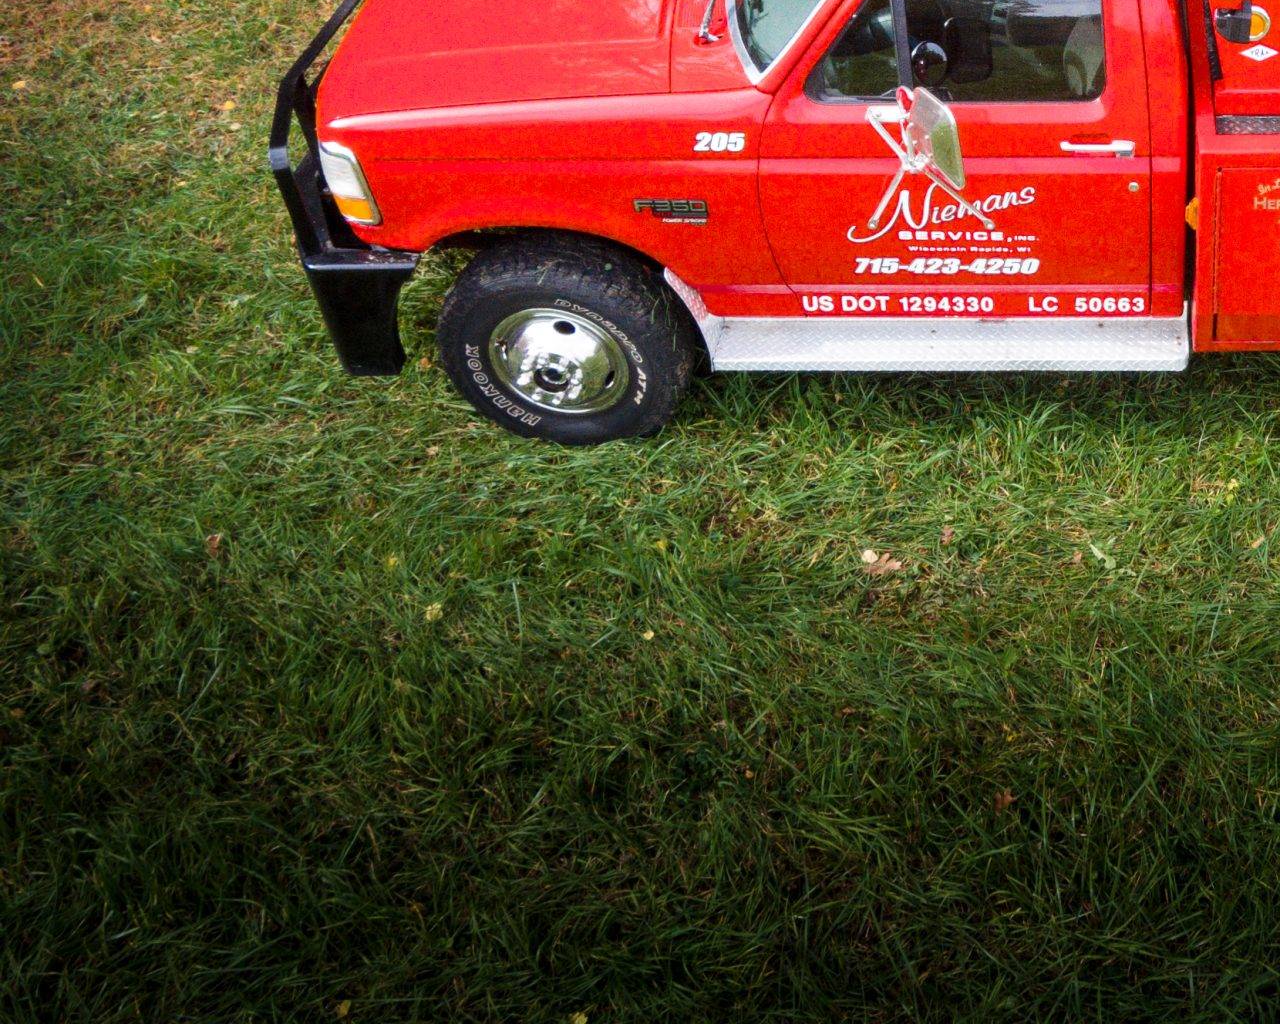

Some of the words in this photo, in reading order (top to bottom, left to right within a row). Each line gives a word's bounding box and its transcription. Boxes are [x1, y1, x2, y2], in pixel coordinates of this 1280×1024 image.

[693, 131, 746, 152] 205
[847, 182, 1036, 244] Niemans
[854, 257, 1040, 275] 715-423-4250
[802, 296, 835, 312] US
[841, 296, 890, 312] DOT
[899, 296, 994, 312] 1294330
[1028, 296, 1059, 312] LC
[1074, 296, 1145, 312] 50663
